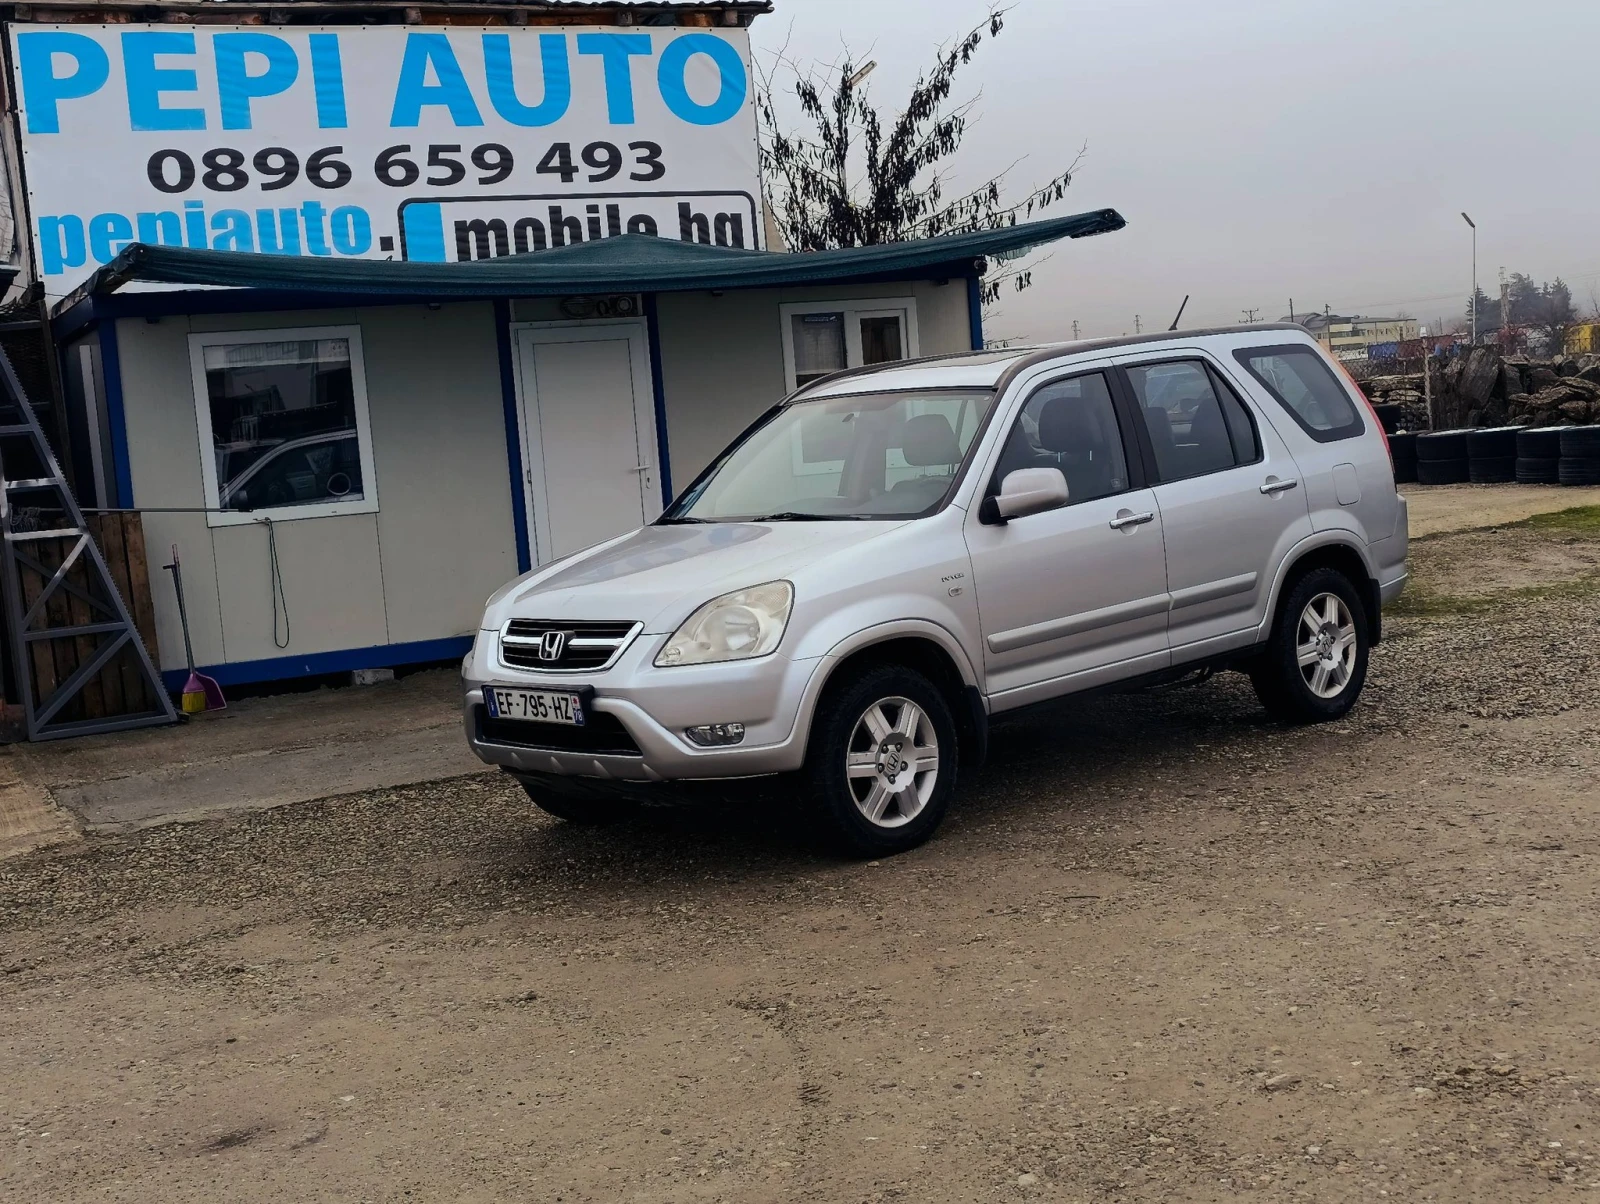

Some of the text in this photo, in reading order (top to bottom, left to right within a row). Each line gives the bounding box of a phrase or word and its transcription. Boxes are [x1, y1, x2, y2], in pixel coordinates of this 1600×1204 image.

[18, 31, 747, 134] PEPI AUTO
[147, 140, 666, 193] 0896 659 493
